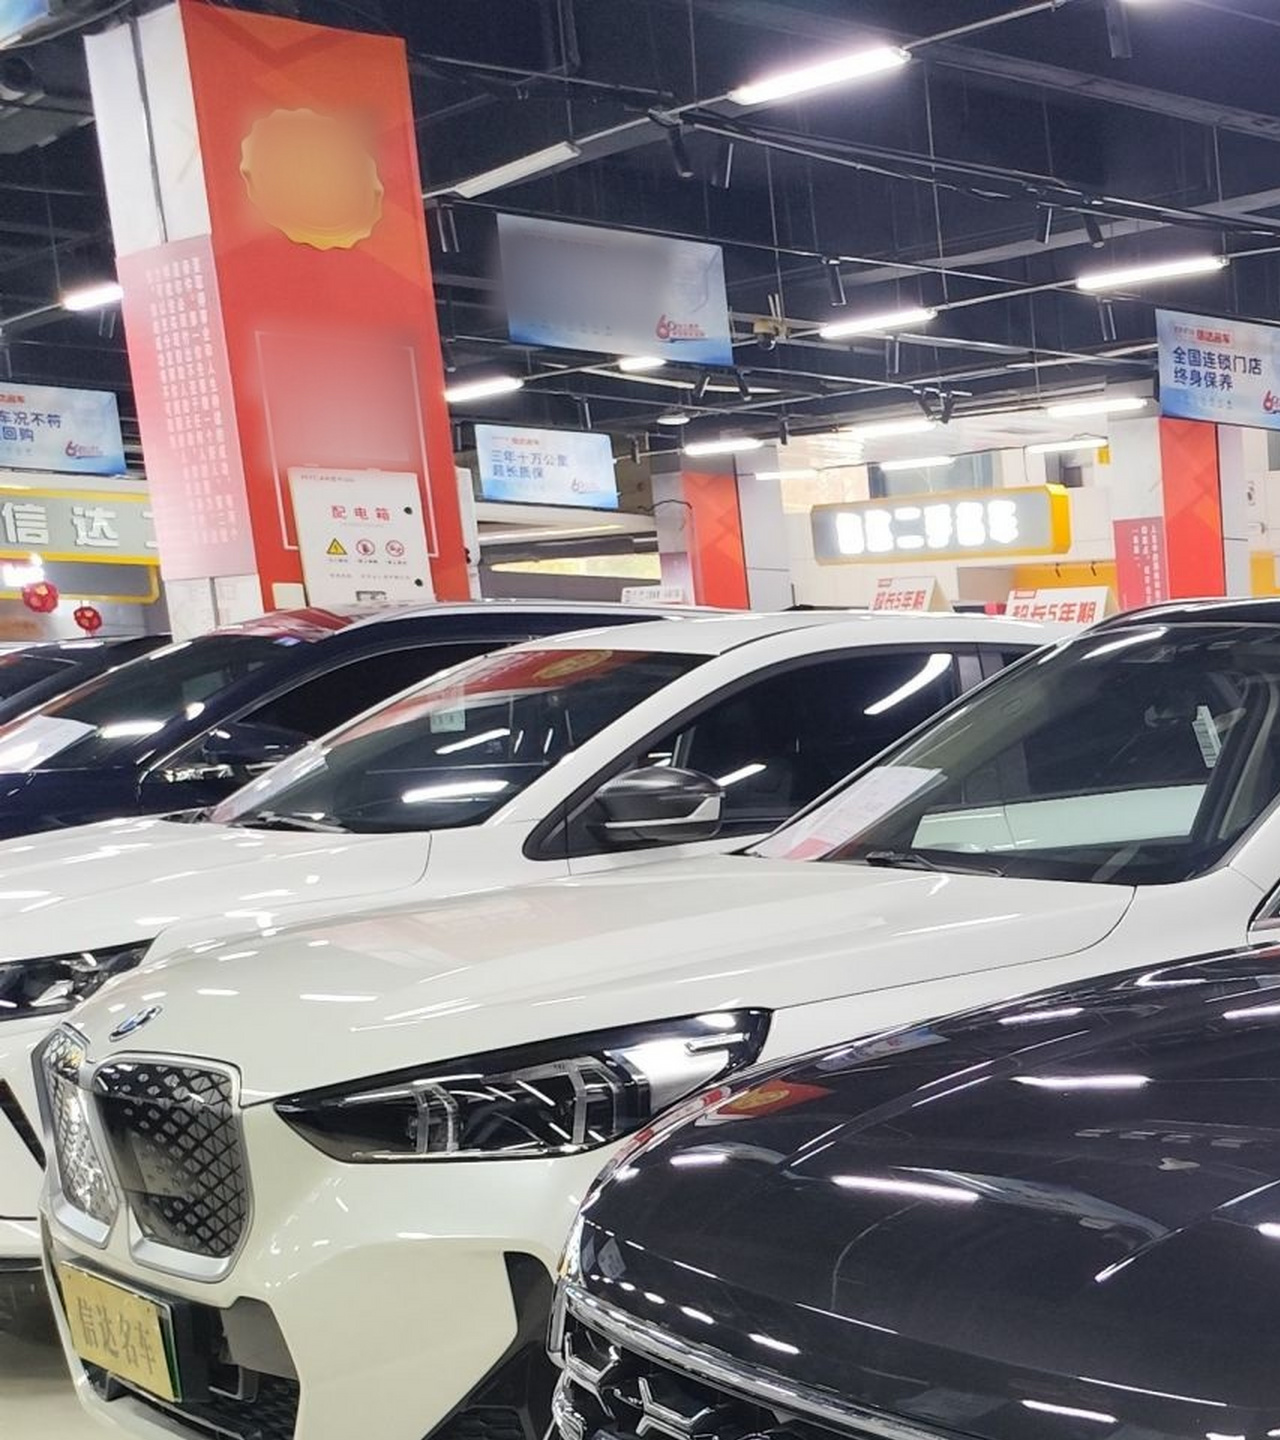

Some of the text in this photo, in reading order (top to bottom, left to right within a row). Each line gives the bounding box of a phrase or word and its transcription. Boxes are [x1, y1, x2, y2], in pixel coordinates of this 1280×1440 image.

[1173, 346, 1262, 375] 全国连锁门店
[1173, 366, 1234, 391] 终身保养
[2, 426, 34, 442] 回购
[491, 449, 569, 467] 三年十万公里
[492, 464, 544, 479] 超长质保
[332, 505, 390, 521] 配电箱
[2, 502, 157, 548] 信达
